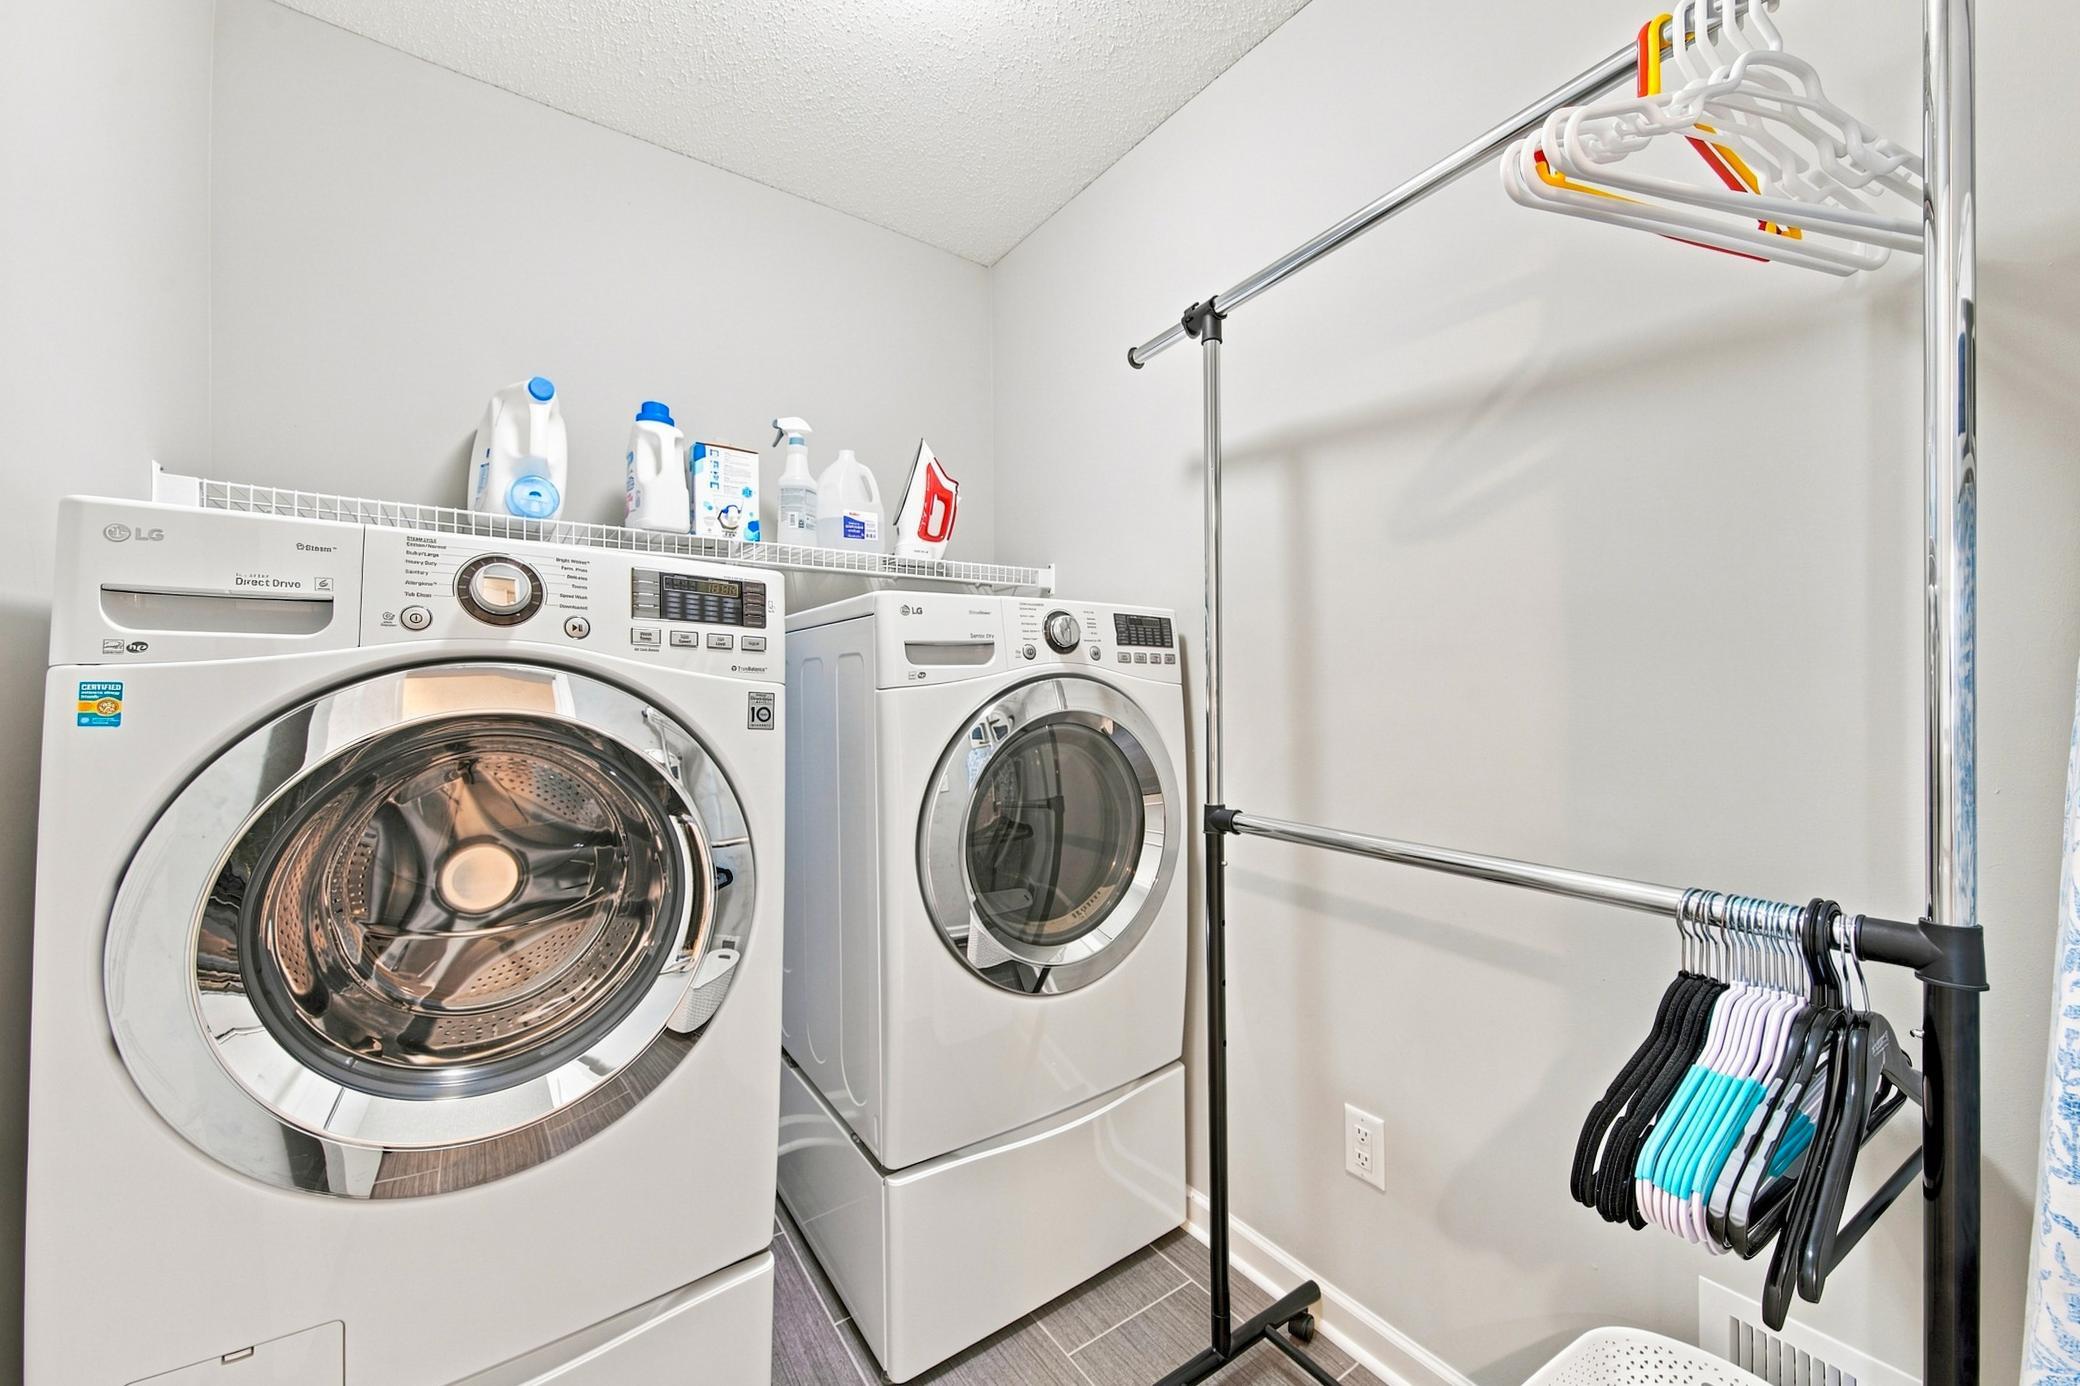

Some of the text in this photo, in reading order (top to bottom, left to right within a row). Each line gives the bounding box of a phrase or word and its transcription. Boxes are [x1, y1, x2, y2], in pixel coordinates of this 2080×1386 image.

[135, 527, 165, 541] LG
[235, 577, 302, 589] Direct Drive
[911, 606, 923, 615] LG
[750, 706, 772, 723] 10
